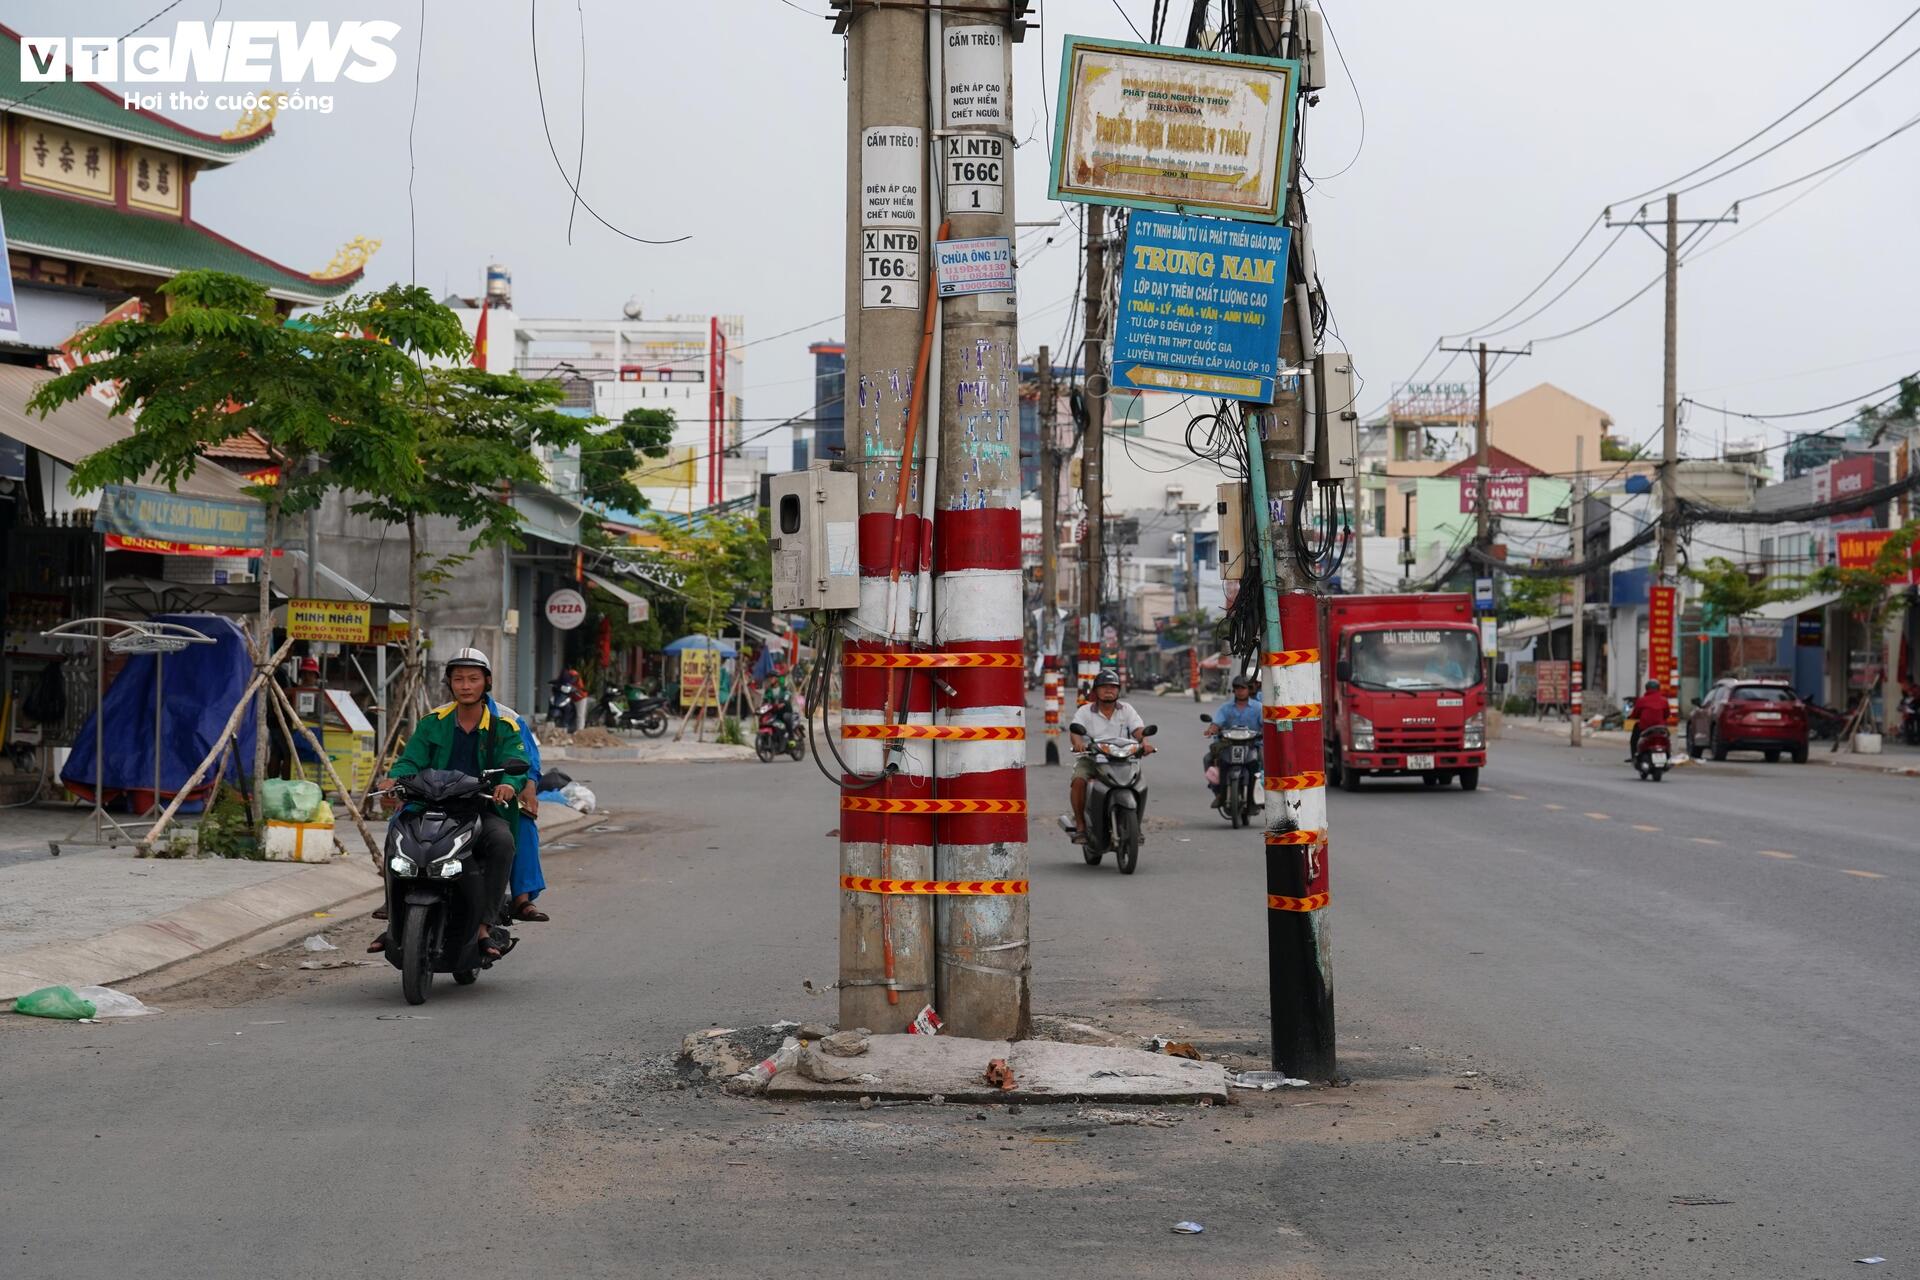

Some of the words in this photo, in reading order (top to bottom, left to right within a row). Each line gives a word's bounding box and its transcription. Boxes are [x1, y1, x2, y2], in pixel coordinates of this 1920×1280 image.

[949, 31, 969, 48] CẤM
[971, 31, 995, 47] TRÈO
[950, 84, 970, 95] ĐIỆN
[972, 83, 985, 93] ÁP
[985, 84, 1000, 93] CAO
[953, 96, 974, 106] NGUY
[977, 93, 998, 105] HIỂM
[951, 108, 974, 119] CHẾT
[976, 106, 1000, 118] NGƯỜI
[866, 132, 887, 148] CẤM
[887, 133, 914, 148] TRÈO
[950, 139, 960, 156] X
[967, 139, 1002, 156] NTĐ
[952, 162, 999, 182] T66C
[866, 184, 887, 195] ĐIỆN
[888, 183, 901, 193] ÁP
[902, 184, 917, 194] CAO
[869, 197, 890, 207] NGUY
[892, 195, 914, 207] HIỂM
[971, 190, 981, 208] 1
[866, 208, 889, 220] CHẾT
[891, 207, 916, 220] NGƯỜI
[866, 233, 875, 250] X
[883, 234, 918, 251] NTĐ
[1153, 223, 1172, 240] TNHH
[1173, 220, 1187, 241] ĐẦU
[1199, 225, 1208, 243] VÀ
[1209, 225, 1227, 245] PHÁT
[1229, 226, 1249, 248] TRIỂN
[1250, 231, 1267, 249] GIÁO
[1267, 235, 1283, 254] DỤC
[942, 251, 968, 265] CHÙA
[971, 249, 991, 262] ÔNG
[994, 250, 1008, 260] 1/2
[1133, 245, 1216, 277] TRUNG
[1220, 255, 1276, 284] NAM
[880, 285, 892, 304] 2
[1133, 278, 1150, 294] LỚP
[1151, 282, 1168, 298] DẠY
[1170, 282, 1194, 299] THÊM
[1195, 282, 1219, 302] CHẤT
[1220, 287, 1248, 309] LƯỢNG
[1250, 293, 1268, 307] CAO
[1223, 310, 1242, 323] ANH
[1131, 316, 1143, 327] TỪ
[1143, 317, 1159, 329] LỚP
[1167, 318, 1184, 332] ĐẾN
[1186, 321, 1202, 334] LỚP
[1204, 325, 1213, 335] 12
[1128, 332, 1156, 346] LUYỆN
[1158, 335, 1170, 347] THI
[1172, 337, 1193, 349] THPT
[1193, 336, 1217, 351] QUỐC
[1218, 342, 1232, 353] GIA
[1127, 347, 1154, 363] LUYỆN
[1205, 355, 1223, 369] CẤP
[1224, 358, 1242, 370] VÀO
[1243, 360, 1259, 372] LỚP
[1261, 363, 1270, 373] 10
[1491, 485, 1524, 498] HÀNG
[1841, 538, 1865, 559] VĂN
[548, 604, 583, 614] PIZZA
[295, 612, 325, 623] MINH
[1420, 631, 1441, 644] LONG
